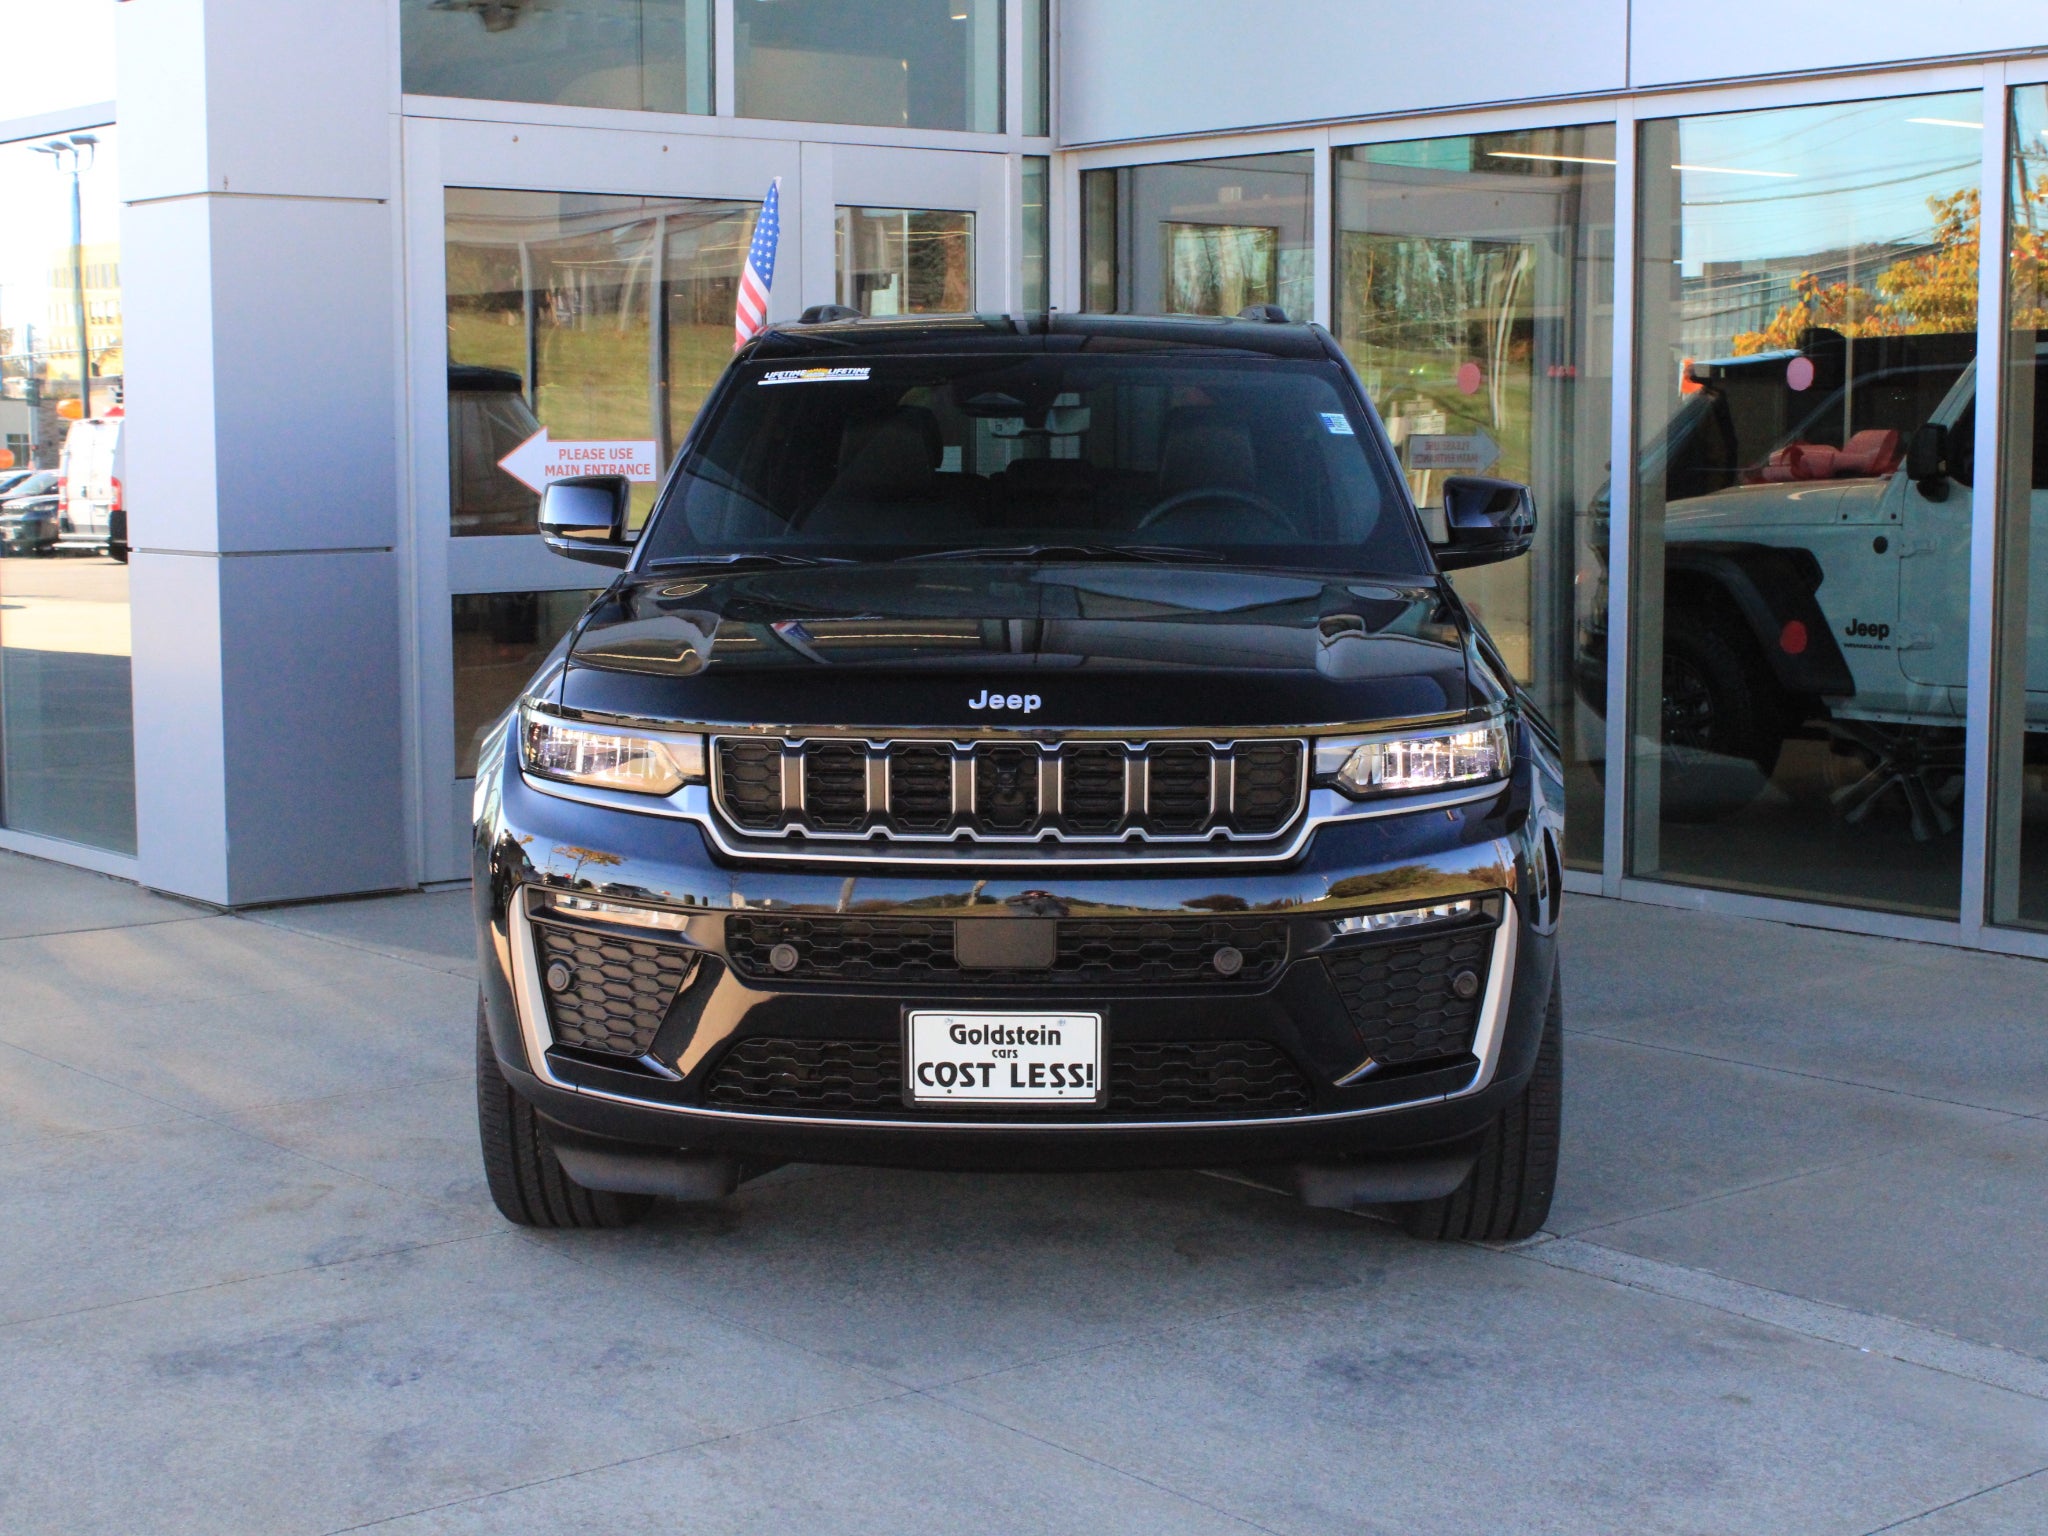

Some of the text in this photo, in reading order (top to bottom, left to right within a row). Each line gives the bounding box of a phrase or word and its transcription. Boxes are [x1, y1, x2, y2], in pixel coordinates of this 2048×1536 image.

[764, 369, 807, 379] LIFETIME
[828, 367, 871, 376] LIFETIME
[558, 448, 634, 460] PLEASE USE
[544, 463, 651, 476] MAIN ENTRANCE
[1845, 618, 1889, 640] Jeep
[968, 690, 1042, 714] Jeep
[949, 1023, 1061, 1046] Goldstein
[991, 1049, 1019, 1059] cars
[917, 1061, 1094, 1089] COST LESS!
